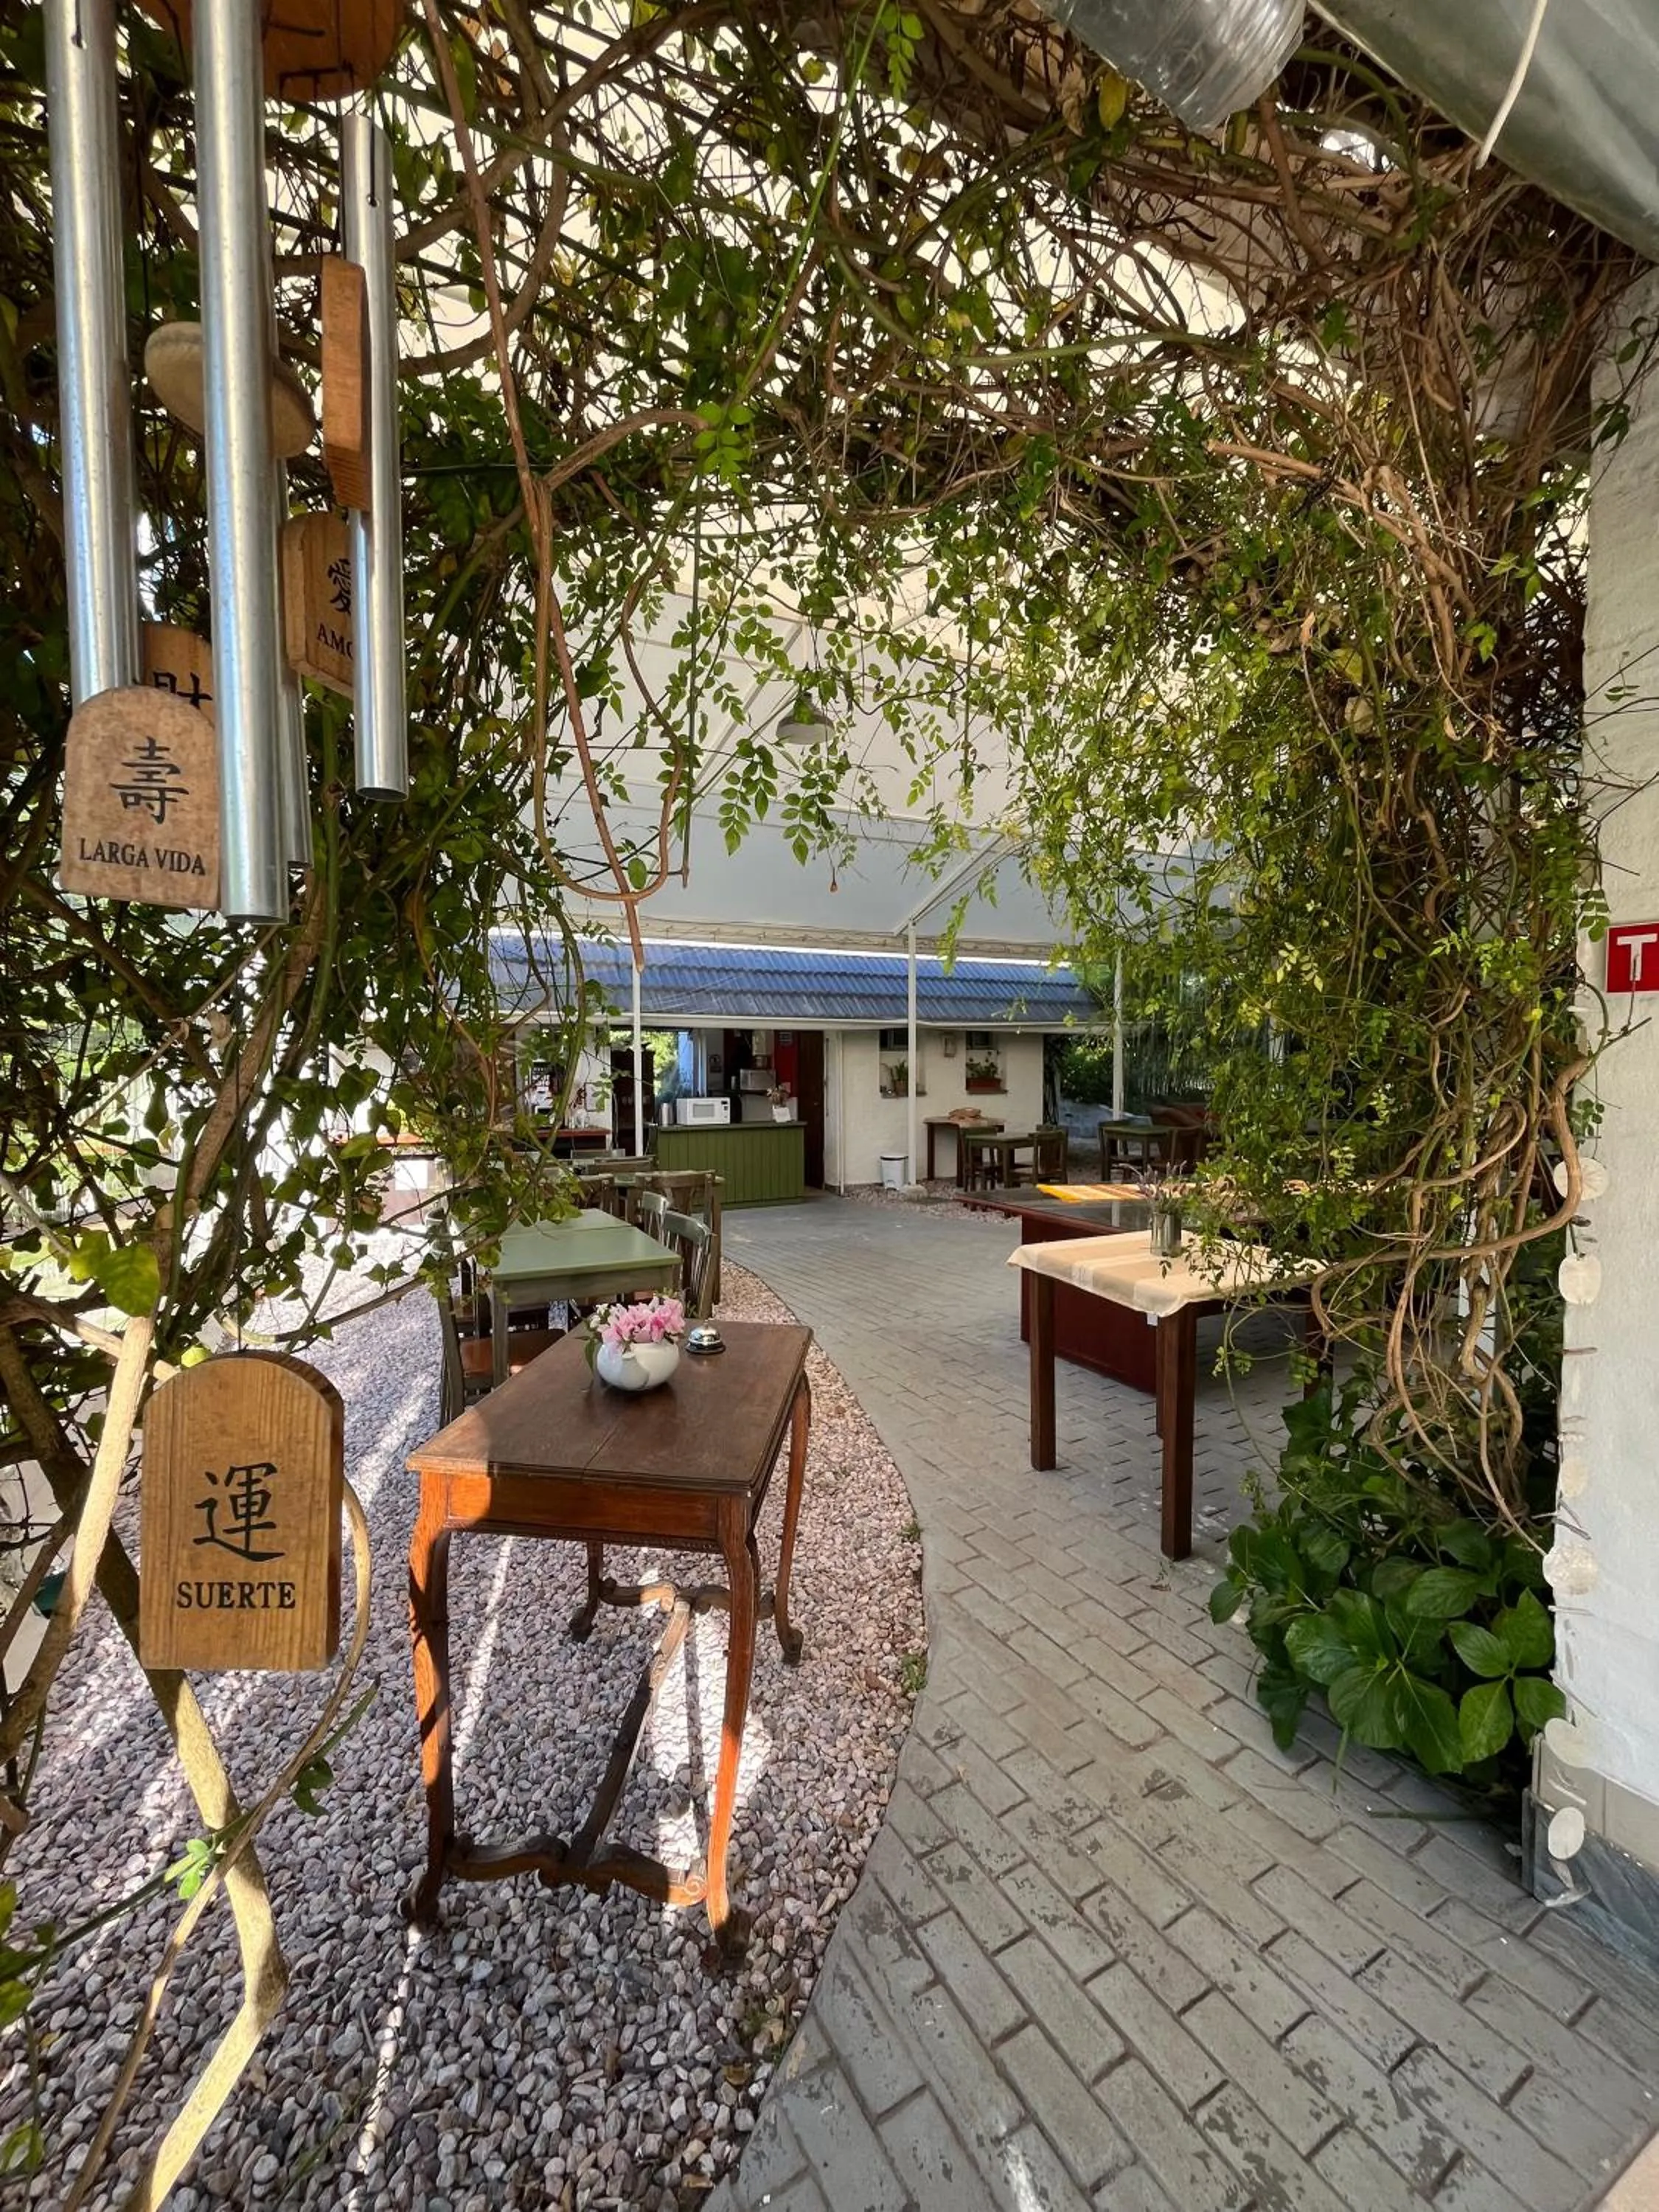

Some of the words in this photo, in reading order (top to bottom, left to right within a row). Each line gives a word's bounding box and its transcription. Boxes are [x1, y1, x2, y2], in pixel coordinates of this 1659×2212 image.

[79, 837, 150, 869] LARGA
[153, 847, 206, 876] VIDA
[193, 1462, 285, 1562] 運
[176, 1581, 296, 1610] SUERTE
